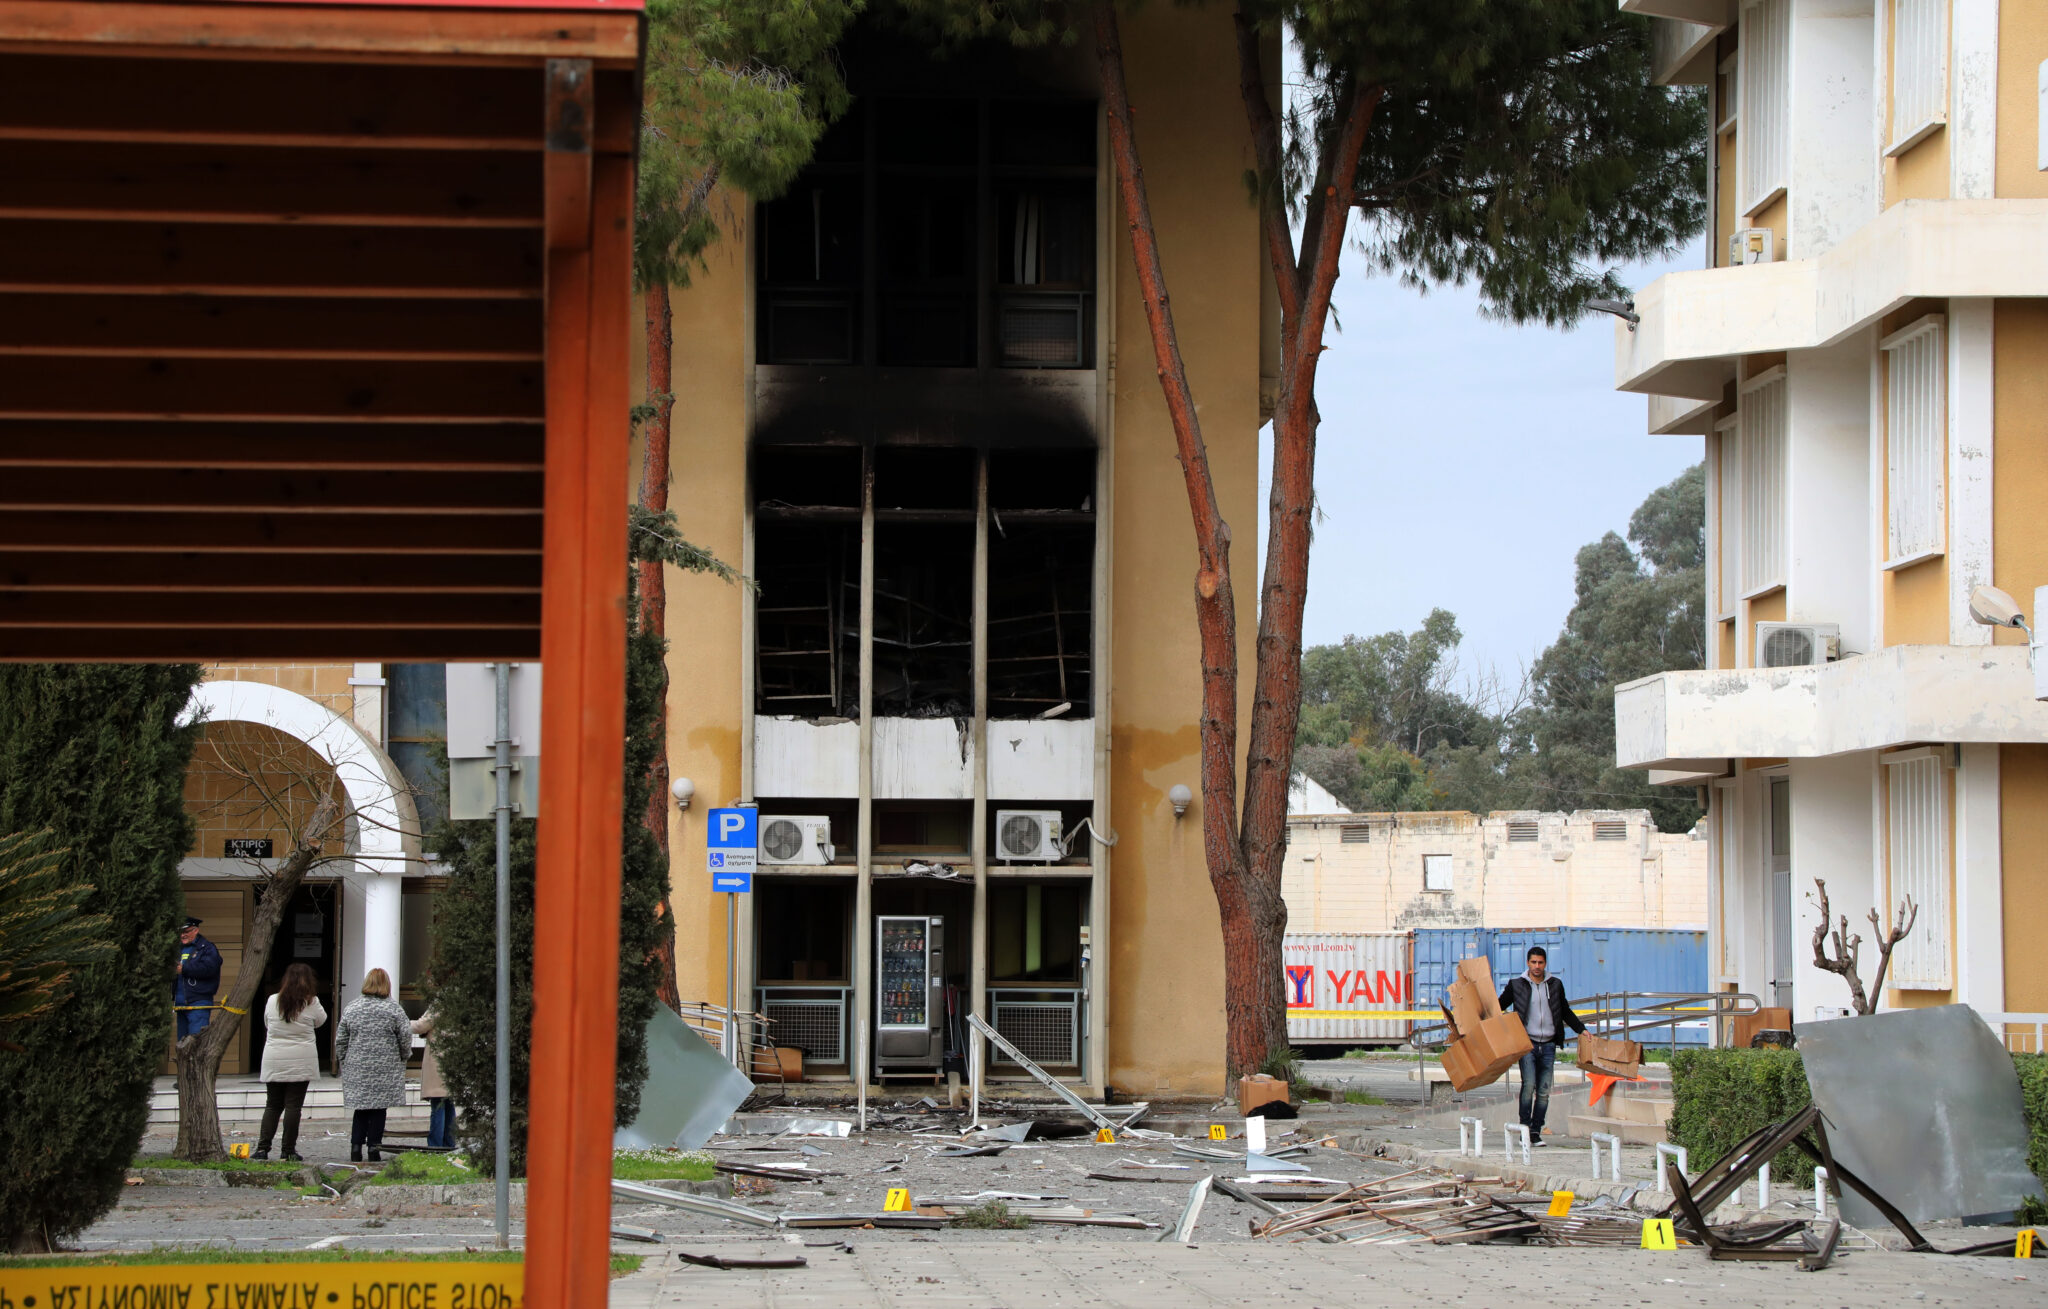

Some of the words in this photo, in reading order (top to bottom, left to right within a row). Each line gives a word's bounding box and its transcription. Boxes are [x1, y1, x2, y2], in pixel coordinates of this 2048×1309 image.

[720, 814, 745, 841] P
[254, 848, 261, 856] 4
[1214, 1127, 1222, 1138] 11
[236, 1145, 242, 1155] 6
[892, 1191, 899, 1207] 7
[1656, 1221, 1664, 1245] 1
[2020, 1233, 2026, 1256] 3
